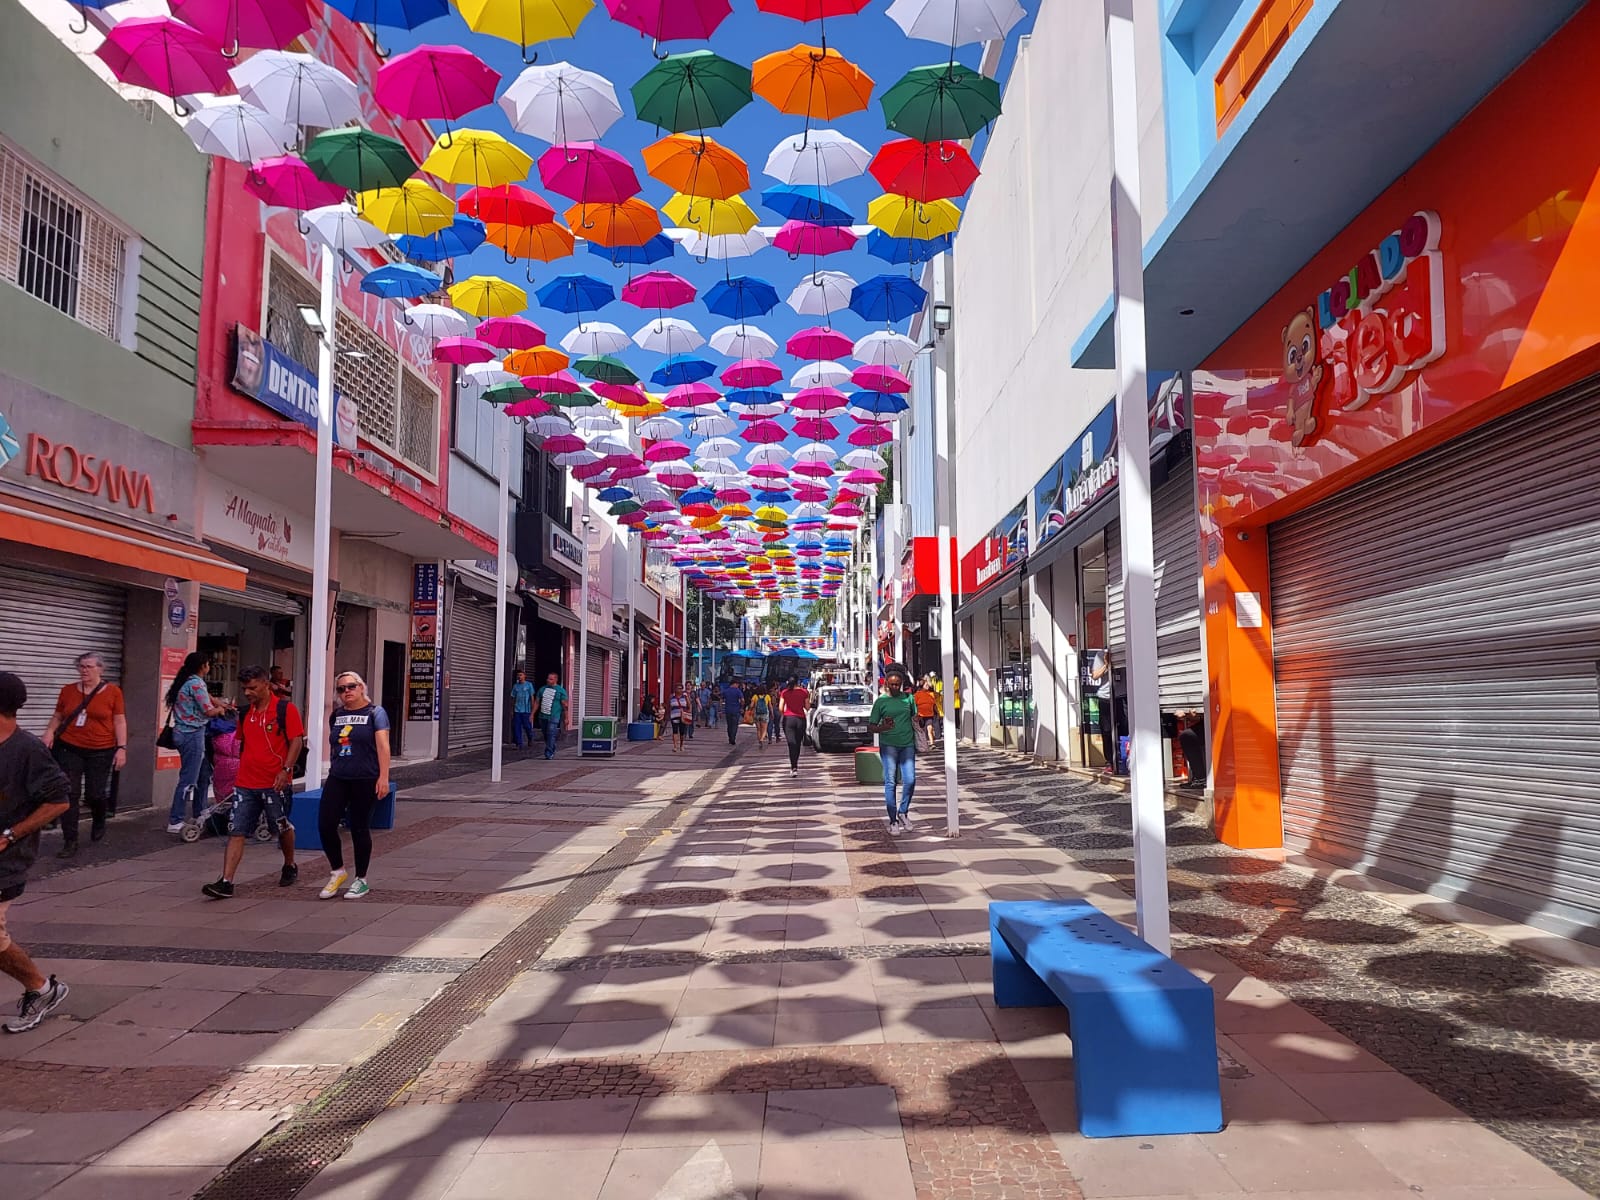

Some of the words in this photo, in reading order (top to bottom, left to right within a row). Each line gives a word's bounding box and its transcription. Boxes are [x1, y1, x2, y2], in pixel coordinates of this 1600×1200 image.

[1318, 252, 1383, 329] LOJA
[1379, 215, 1428, 280] DO
[268, 359, 319, 418] DENTIS
[26, 432, 155, 514] ROSANA
[225, 495, 239, 519] A
[237, 499, 277, 535] Magnata
[350, 716, 365, 724] MAN
